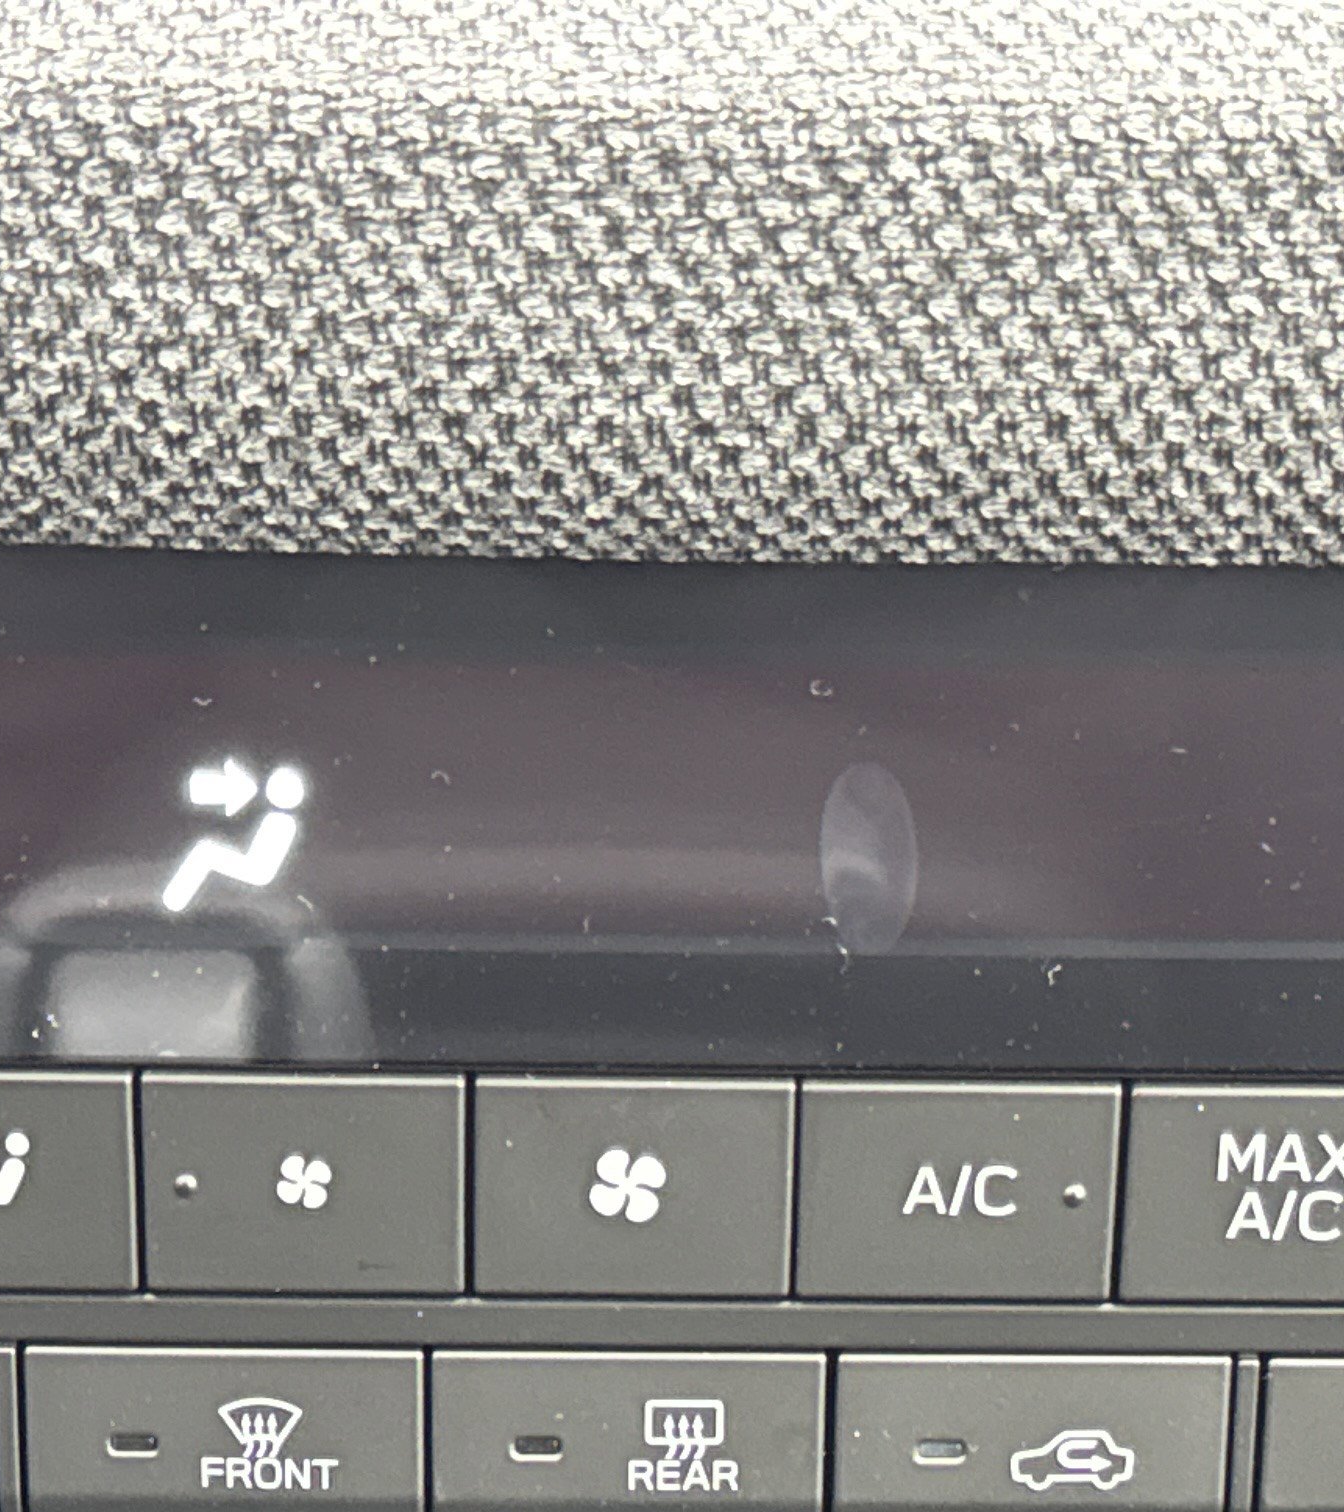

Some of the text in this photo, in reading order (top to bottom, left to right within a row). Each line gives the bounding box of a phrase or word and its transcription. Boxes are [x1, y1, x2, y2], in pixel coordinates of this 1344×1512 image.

[901, 1163, 1020, 1218] A/C
[199, 1456, 341, 1492] FRONT
[626, 1458, 740, 1493] REAR
